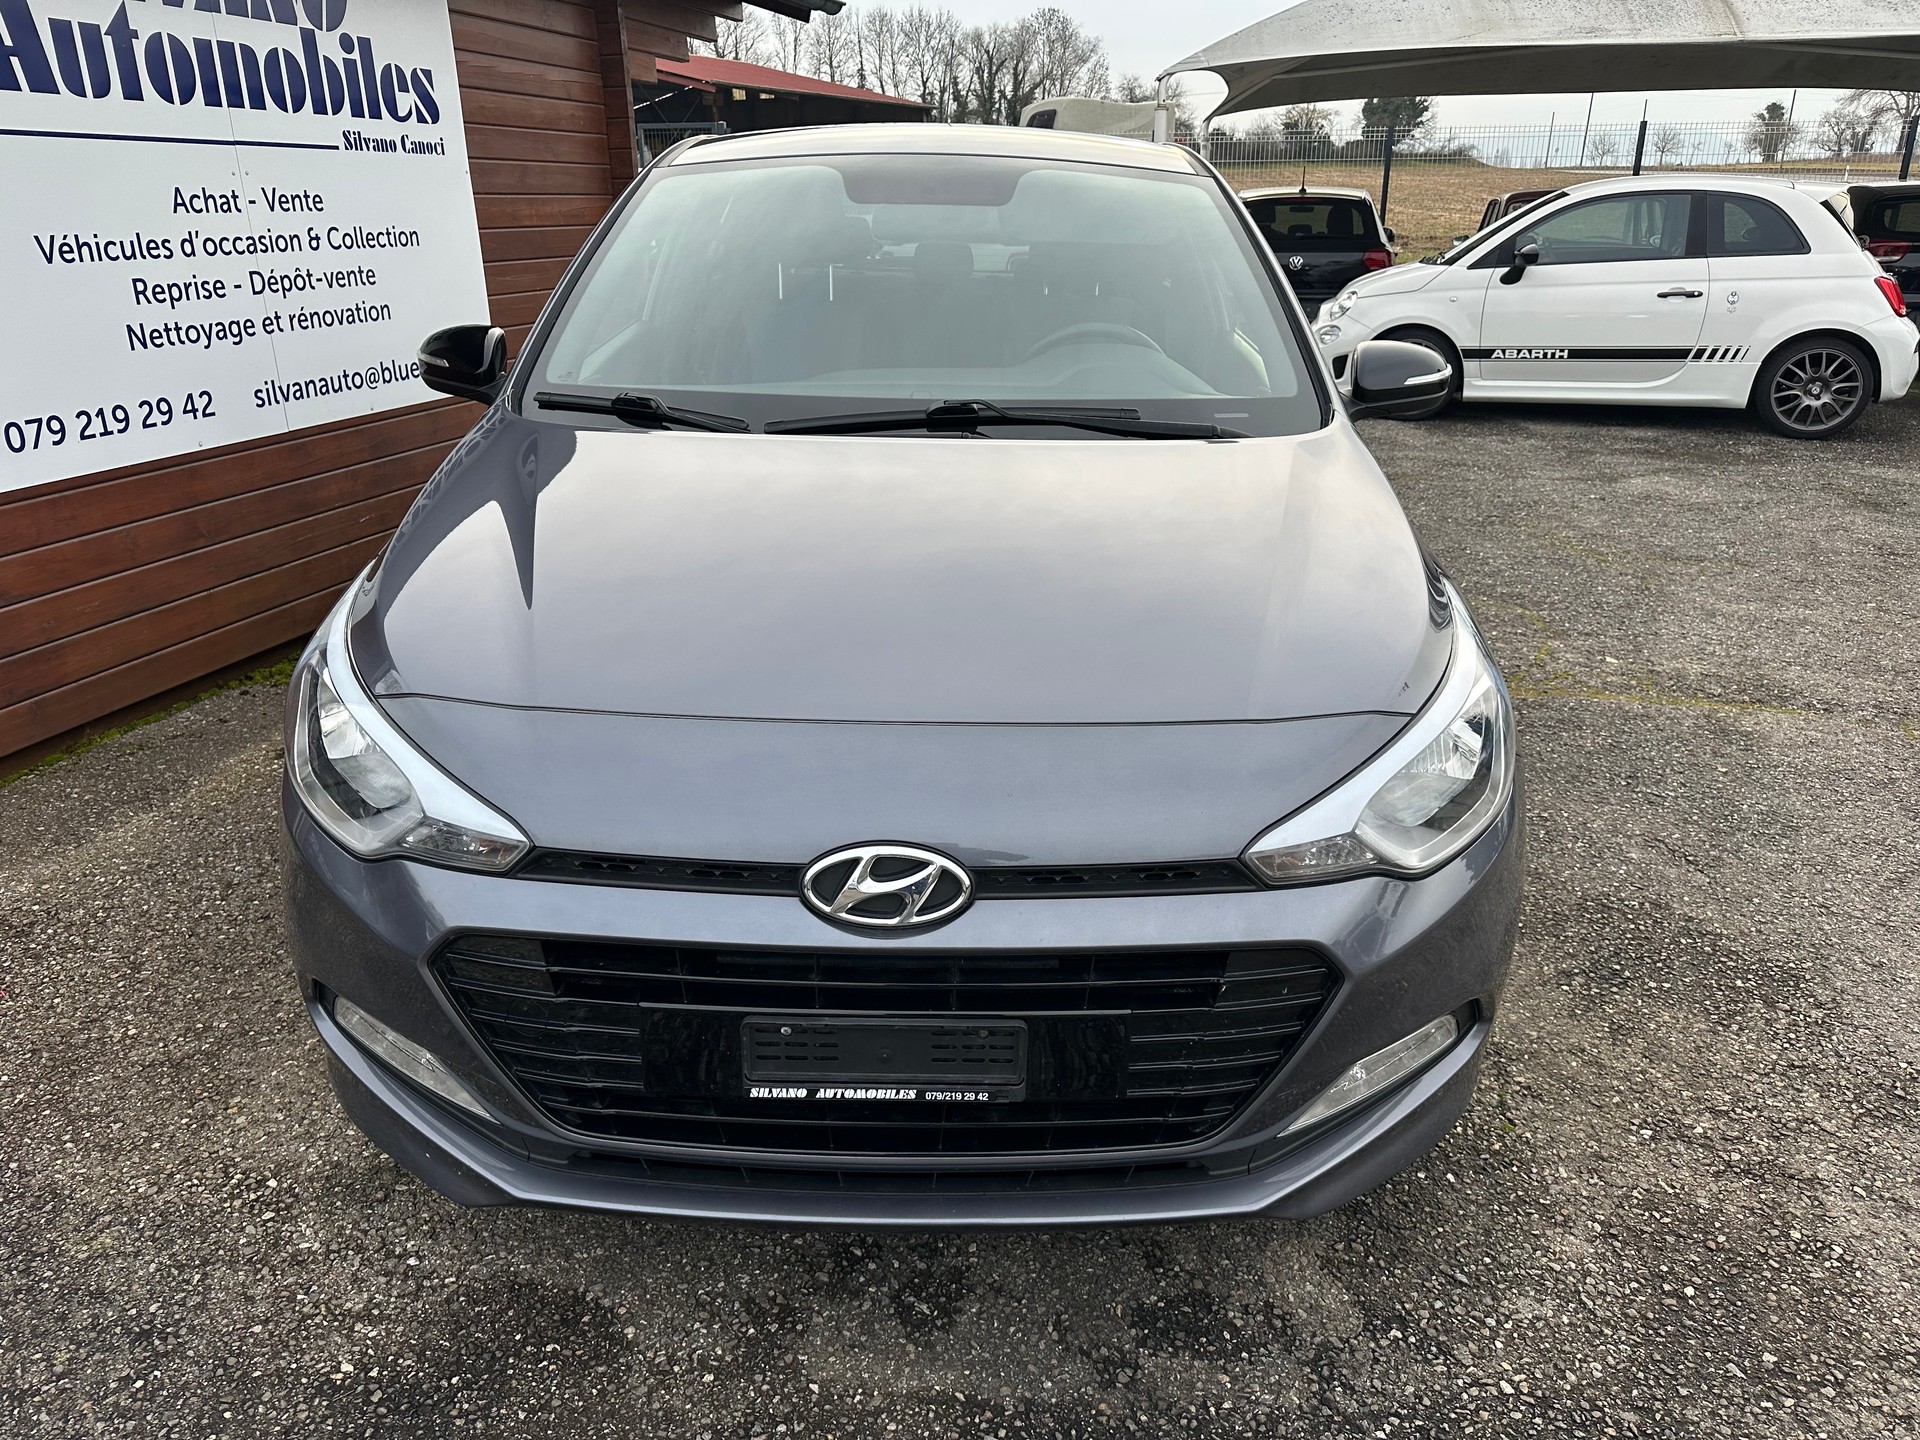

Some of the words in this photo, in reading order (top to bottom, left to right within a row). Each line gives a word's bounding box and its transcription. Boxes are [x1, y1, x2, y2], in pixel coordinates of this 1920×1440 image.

[0, 0, 441, 125] Automobiles
[342, 129, 398, 154] Silvano
[400, 134, 446, 156] Canoci
[172, 186, 243, 214] Achat
[260, 187, 325, 213] Vente
[33, 232, 174, 265] Véhicules
[306, 226, 322, 252] &
[326, 225, 420, 251] Collection
[131, 274, 227, 310] Reprise
[248, 265, 377, 300] Dépôt-vente
[125, 317, 257, 352] Nettoyage
[261, 310, 285, 335] et
[288, 301, 392, 332] rénovation
[1491, 349, 1569, 359] ABARTH
[3, 414, 67, 454] 079
[74, 403, 131, 441] 219
[138, 397, 174, 430] 29
[182, 389, 216, 420] 42
[750, 1087, 808, 1099] SILVANO
[815, 1088, 917, 1100] AUTOMOBILES
[925, 1091, 962, 1101] 079/219
[963, 1092, 976, 1101] 29
[976, 1092, 989, 1101] 42
